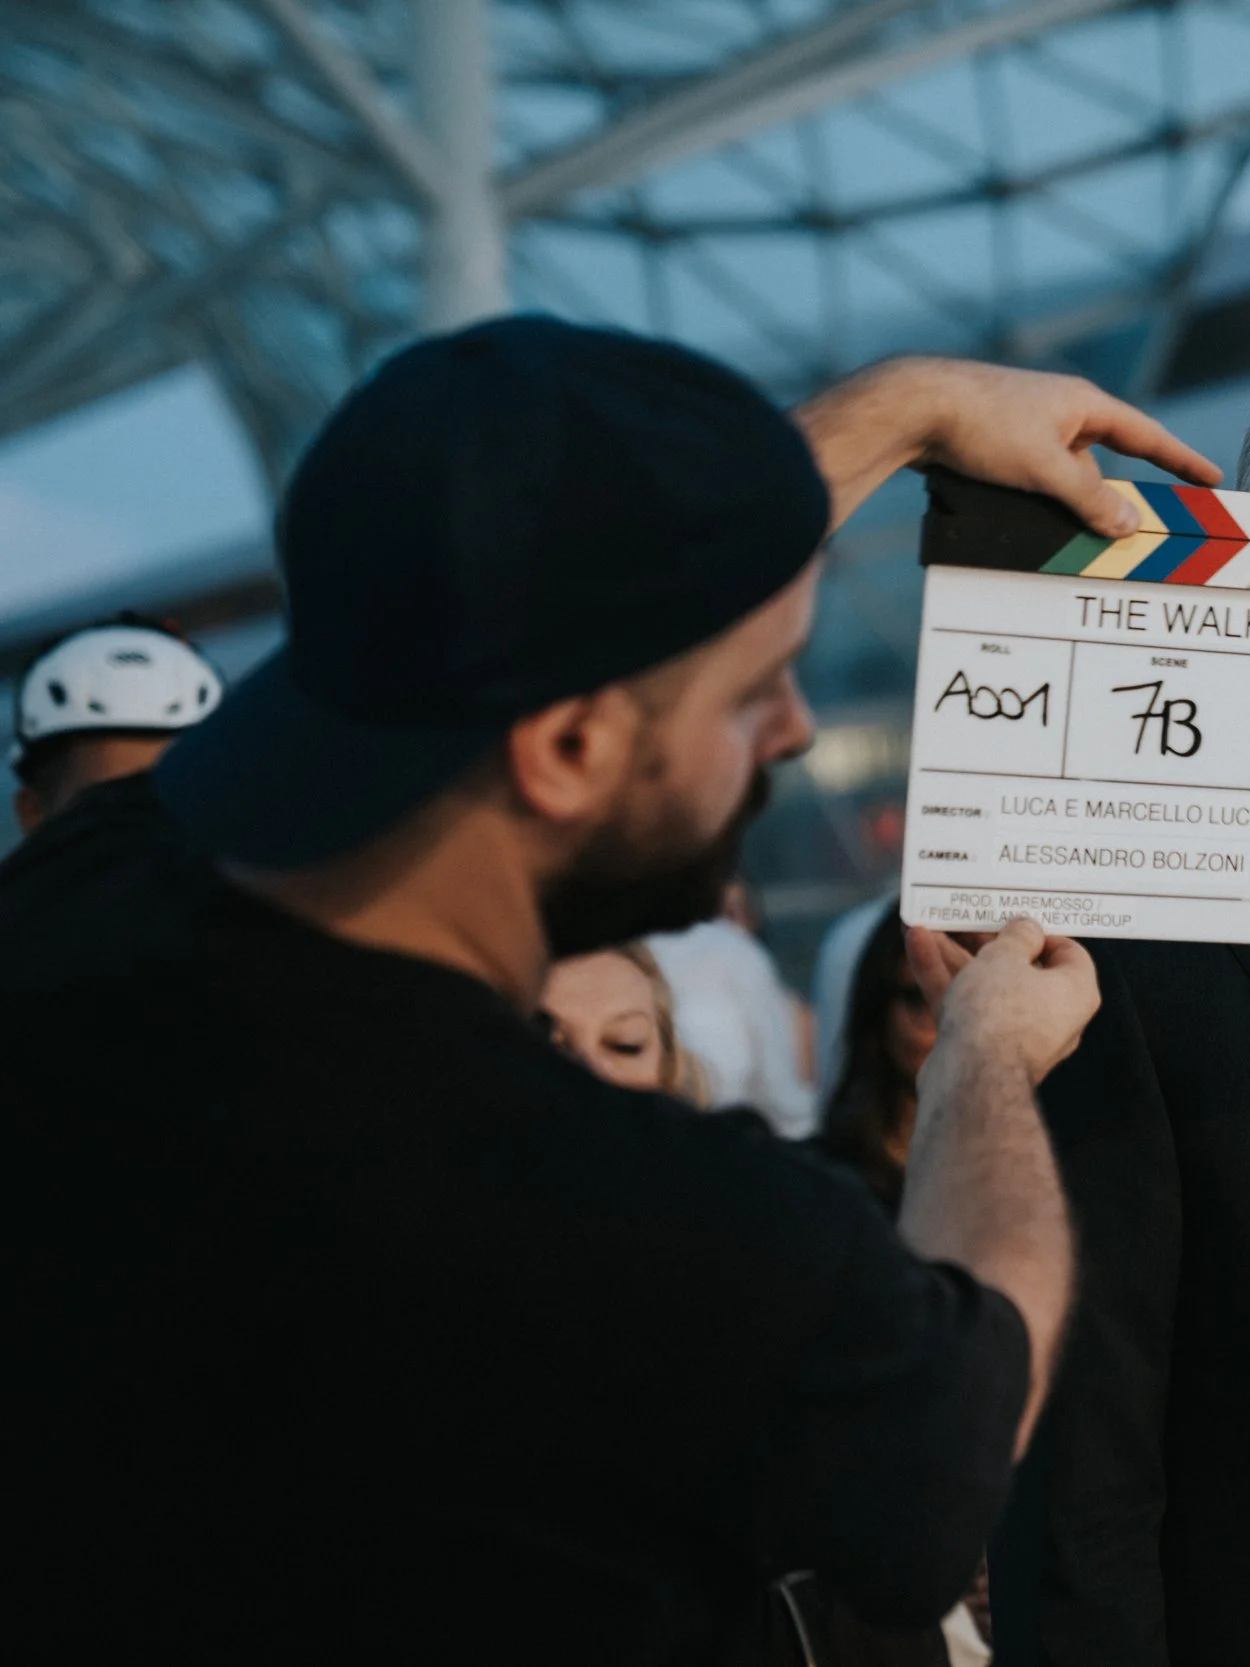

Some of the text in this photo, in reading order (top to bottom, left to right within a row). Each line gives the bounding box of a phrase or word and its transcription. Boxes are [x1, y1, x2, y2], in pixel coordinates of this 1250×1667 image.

[1075, 595, 1149, 631] THE
[980, 642, 1011, 655] ROLL
[1151, 656, 1188, 669] SCENE
[934, 670, 1050, 727] A001
[1111, 680, 1202, 757] 7B
[1000, 795, 1058, 817] LUCA
[1064, 798, 1079, 818] E
[1084, 799, 1203, 824] MARCELLO
[998, 844, 1245, 873] ALESSANDRO BOLZONI
[928, 907, 971, 920] FIERA
[1041, 911, 1132, 928] NEXTGROUP
[998, 896, 1094, 912] MAREMOSSO
